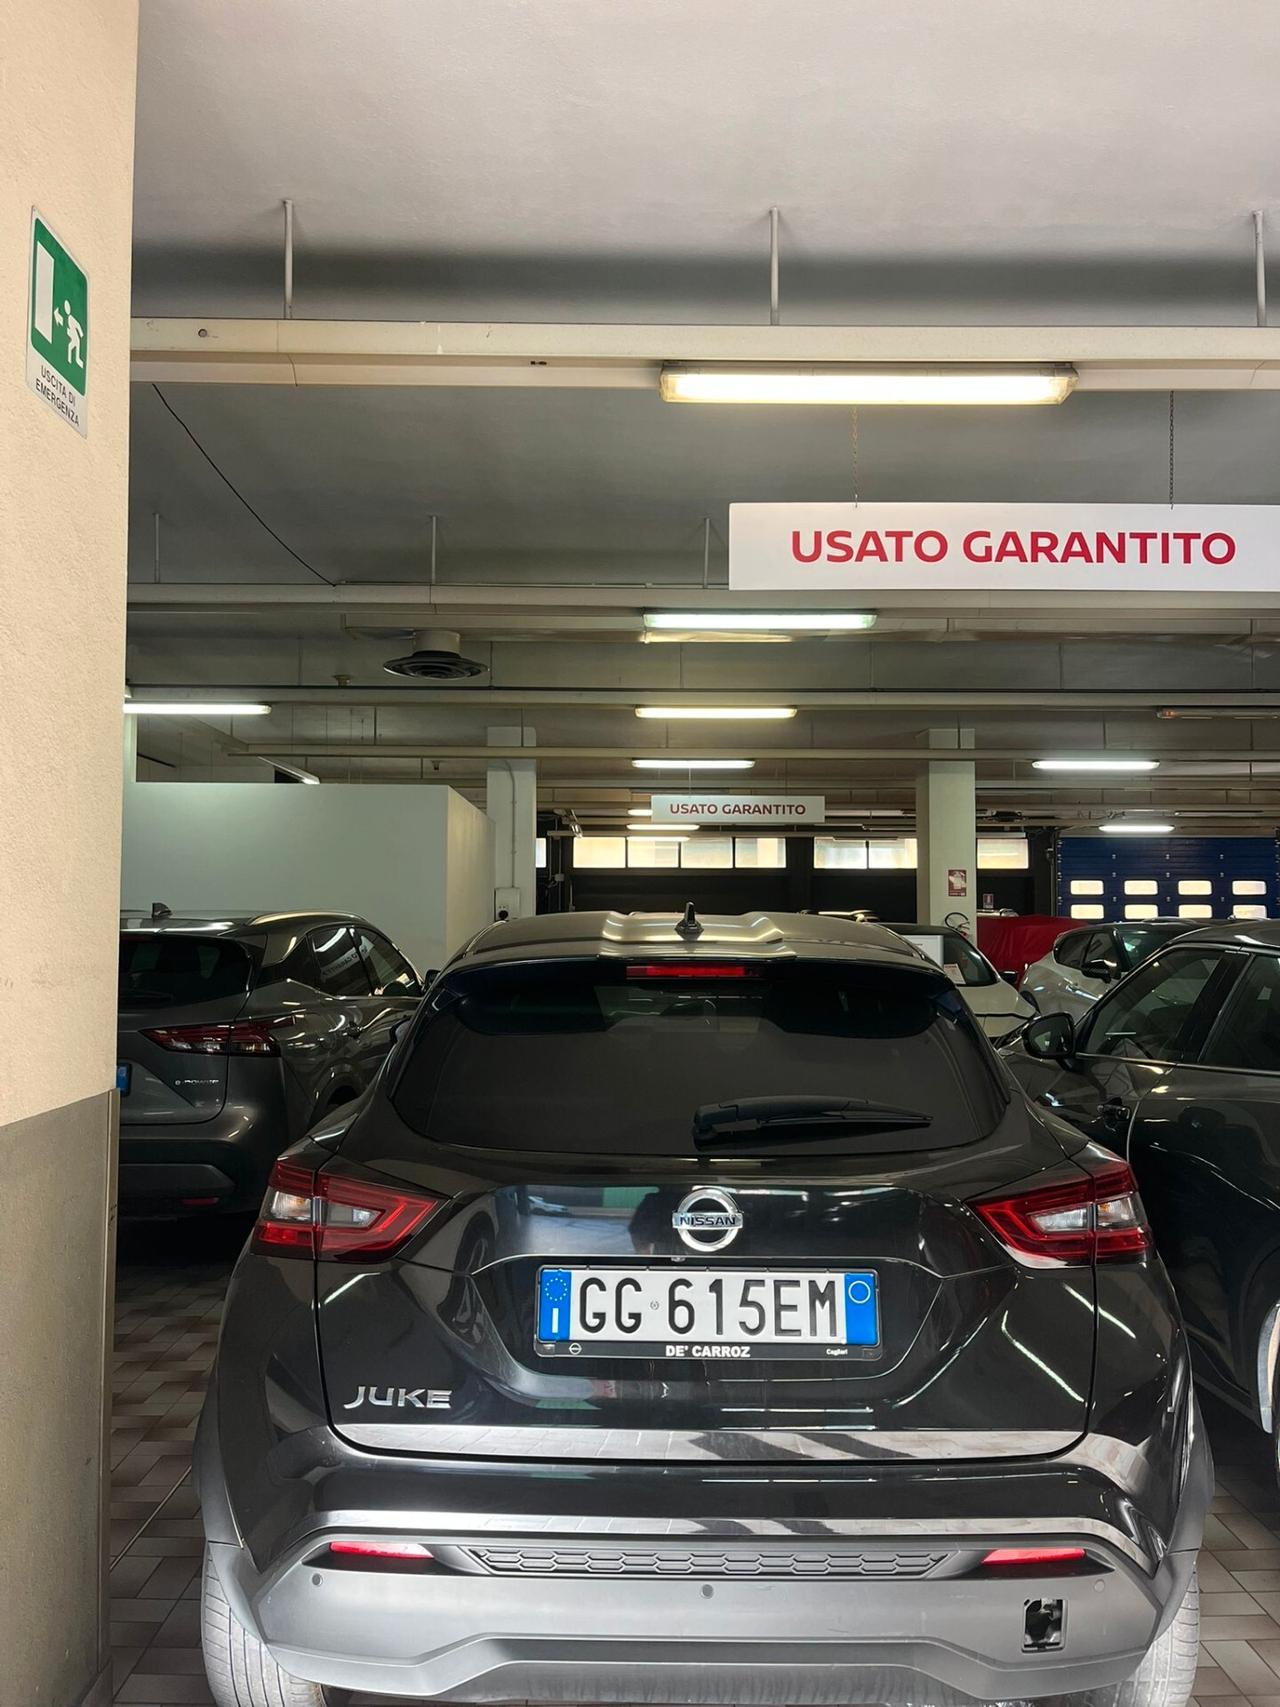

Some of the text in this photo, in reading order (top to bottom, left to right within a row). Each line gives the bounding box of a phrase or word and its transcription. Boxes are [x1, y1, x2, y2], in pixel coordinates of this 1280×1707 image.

[41, 364, 76, 407] USCITA DI
[35, 377, 80, 427] EMERGENZA
[791, 530, 1237, 565] USATO GARANTITO
[670, 803, 806, 815] USATO GARANTITO
[679, 1216, 736, 1226] NISSAN
[579, 1277, 837, 1337] GG 615EM
[665, 1345, 751, 1358] DE' CARROZ
[343, 1386, 453, 1410] JUKE
